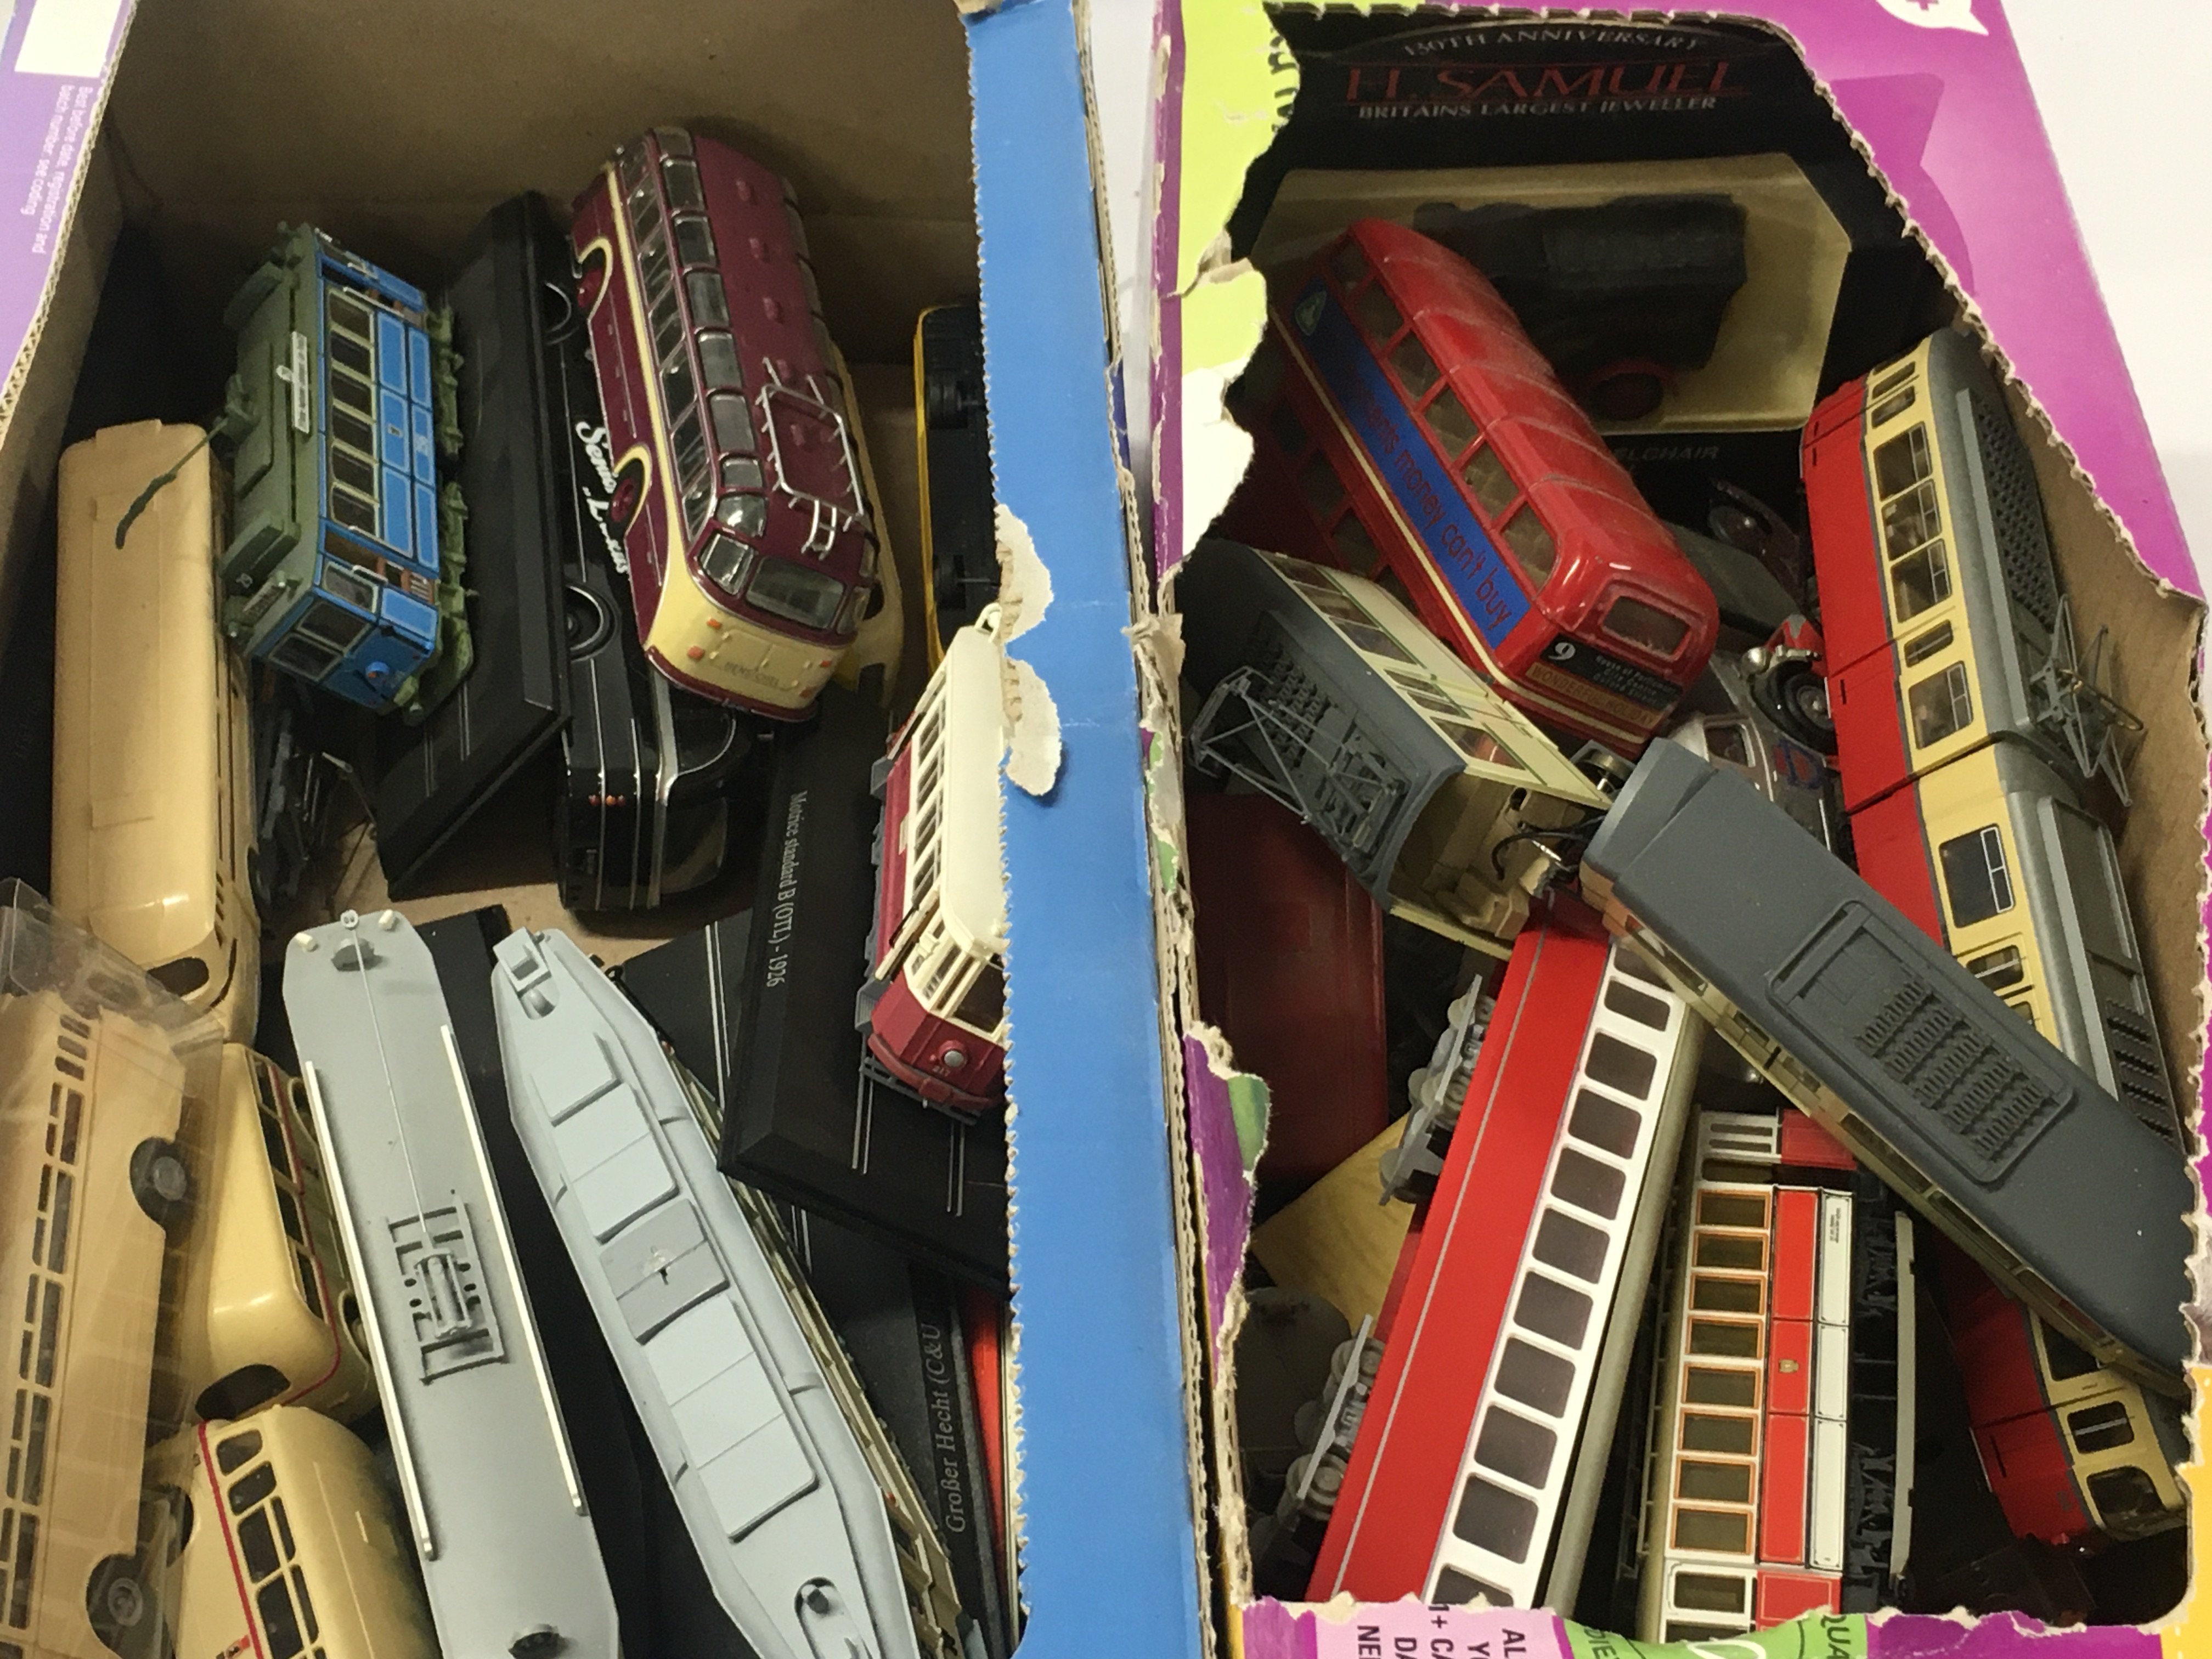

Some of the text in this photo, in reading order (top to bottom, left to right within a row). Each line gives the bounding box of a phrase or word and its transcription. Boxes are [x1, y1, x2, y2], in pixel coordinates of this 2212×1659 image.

[1497, 30, 1697, 50] ANNIVERSARY
[74, 86, 93, 108] Best
[1436, 61, 1750, 100] SAMUEL
[55, 84, 75, 114] batch
[1358, 98, 1717, 119] BRITAINS LARGEST JEWELLER
[64, 110, 86, 143] before
[35, 159, 50, 178] see
[20, 178, 44, 215] coding
[38, 171, 65, 232] registration
[32, 233, 48, 254] and
[1394, 447, 1446, 528] money
[1441, 523, 1486, 580] can't
[1475, 567, 1513, 631] buy
[1547, 642, 1576, 661] 9
[786, 790, 808, 837] Motrice
[780, 838, 799, 888] standard
[777, 888, 795, 901] B
[768, 902, 794, 944] (OTL)
[766, 953, 788, 988] 1926
[931, 1390, 956, 1452] Hecht
[941, 1457, 966, 1533] Großer
[1357, 1625, 1382, 1659] NE
[1583, 1628, 1620, 1659] DIE
